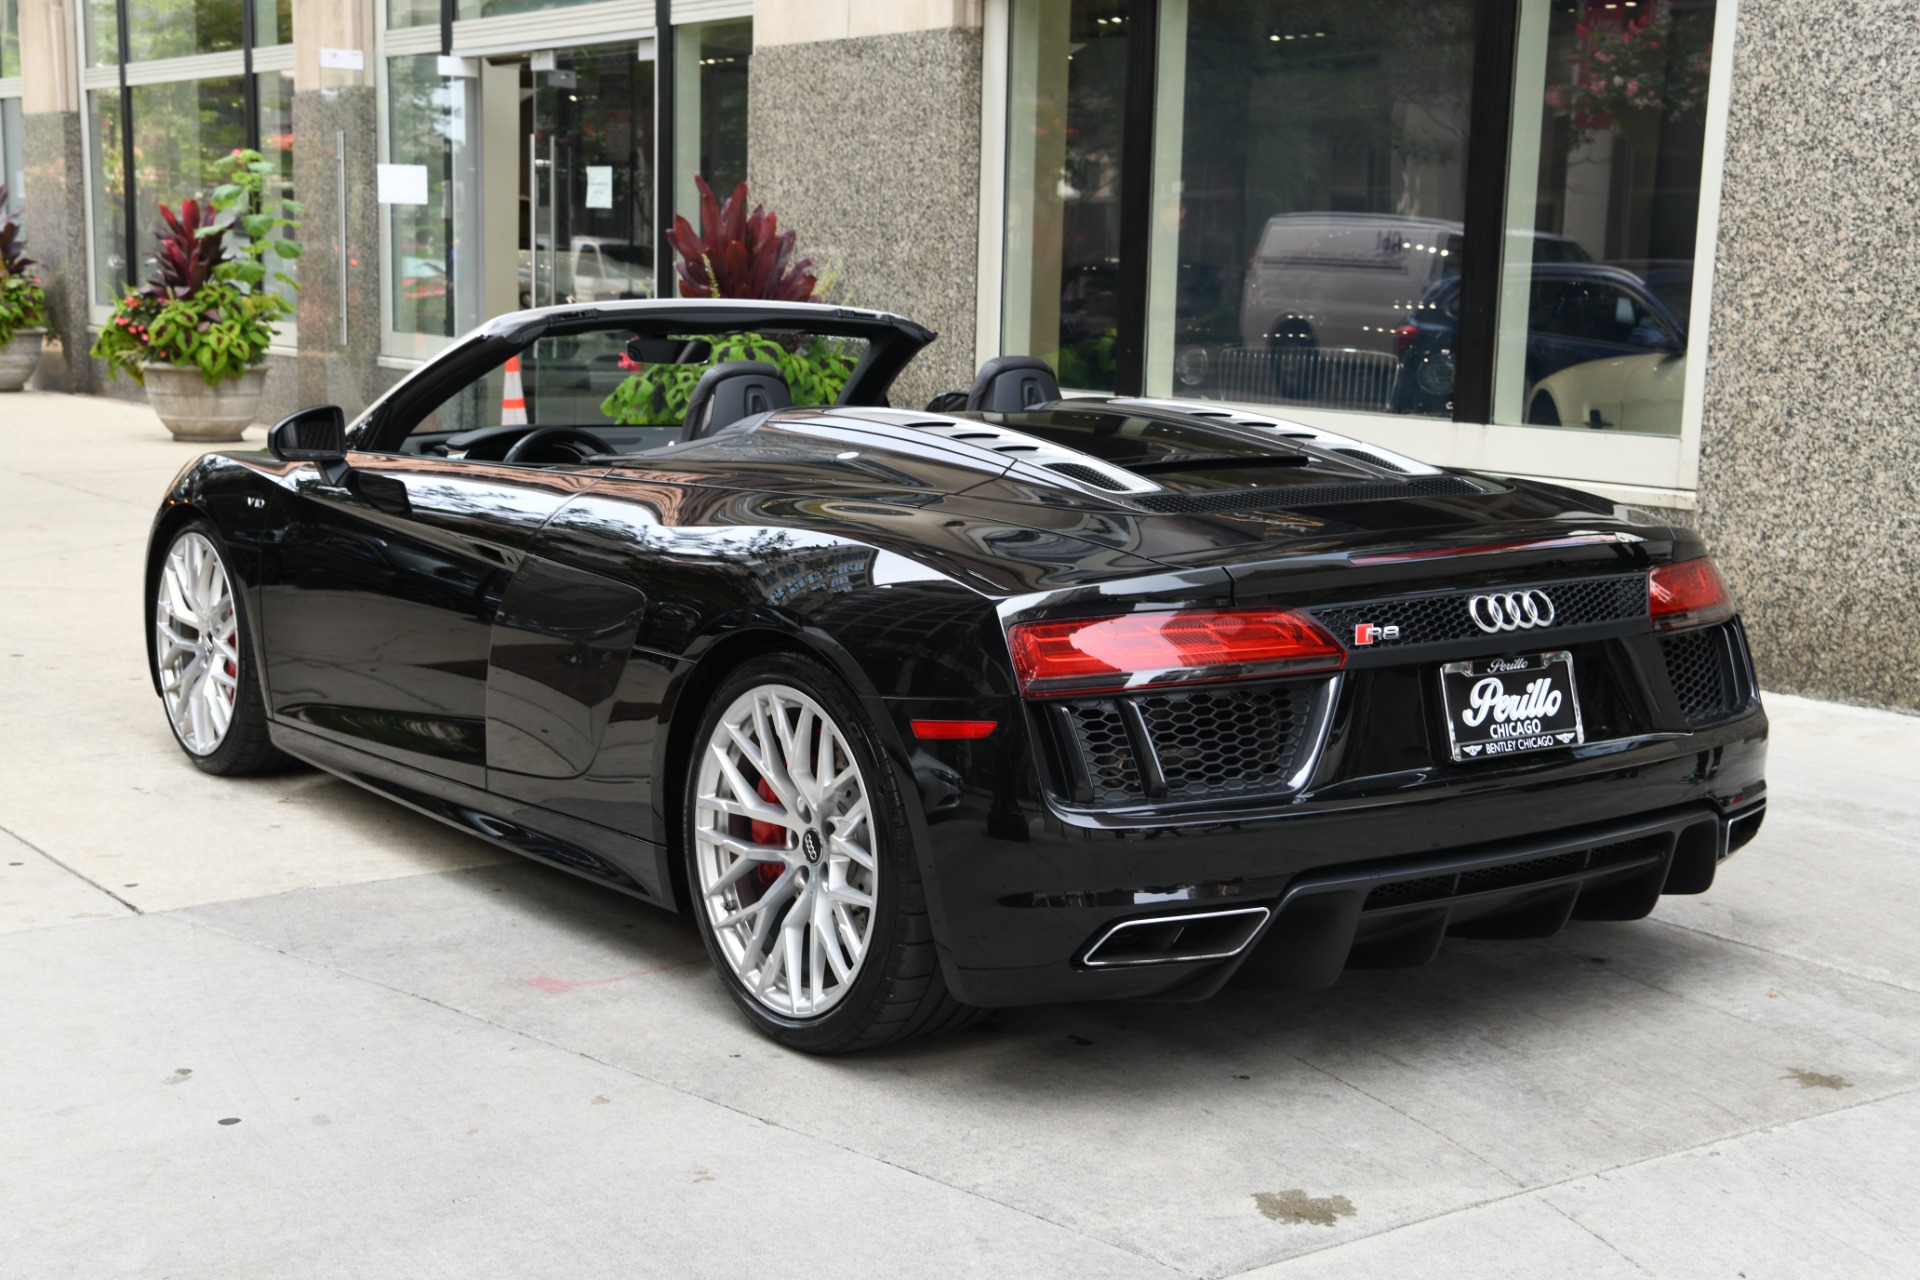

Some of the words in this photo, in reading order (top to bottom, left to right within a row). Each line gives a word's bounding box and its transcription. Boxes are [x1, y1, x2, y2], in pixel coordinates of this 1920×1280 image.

[1365, 625, 1400, 641] R8
[1487, 657, 1528, 673] Perillo
[1462, 677, 1562, 727] Perillo
[1489, 718, 1541, 739] CHICAGO
[1485, 740, 1516, 754] BENTLEY
[1517, 735, 1554, 750] CHICAGO
